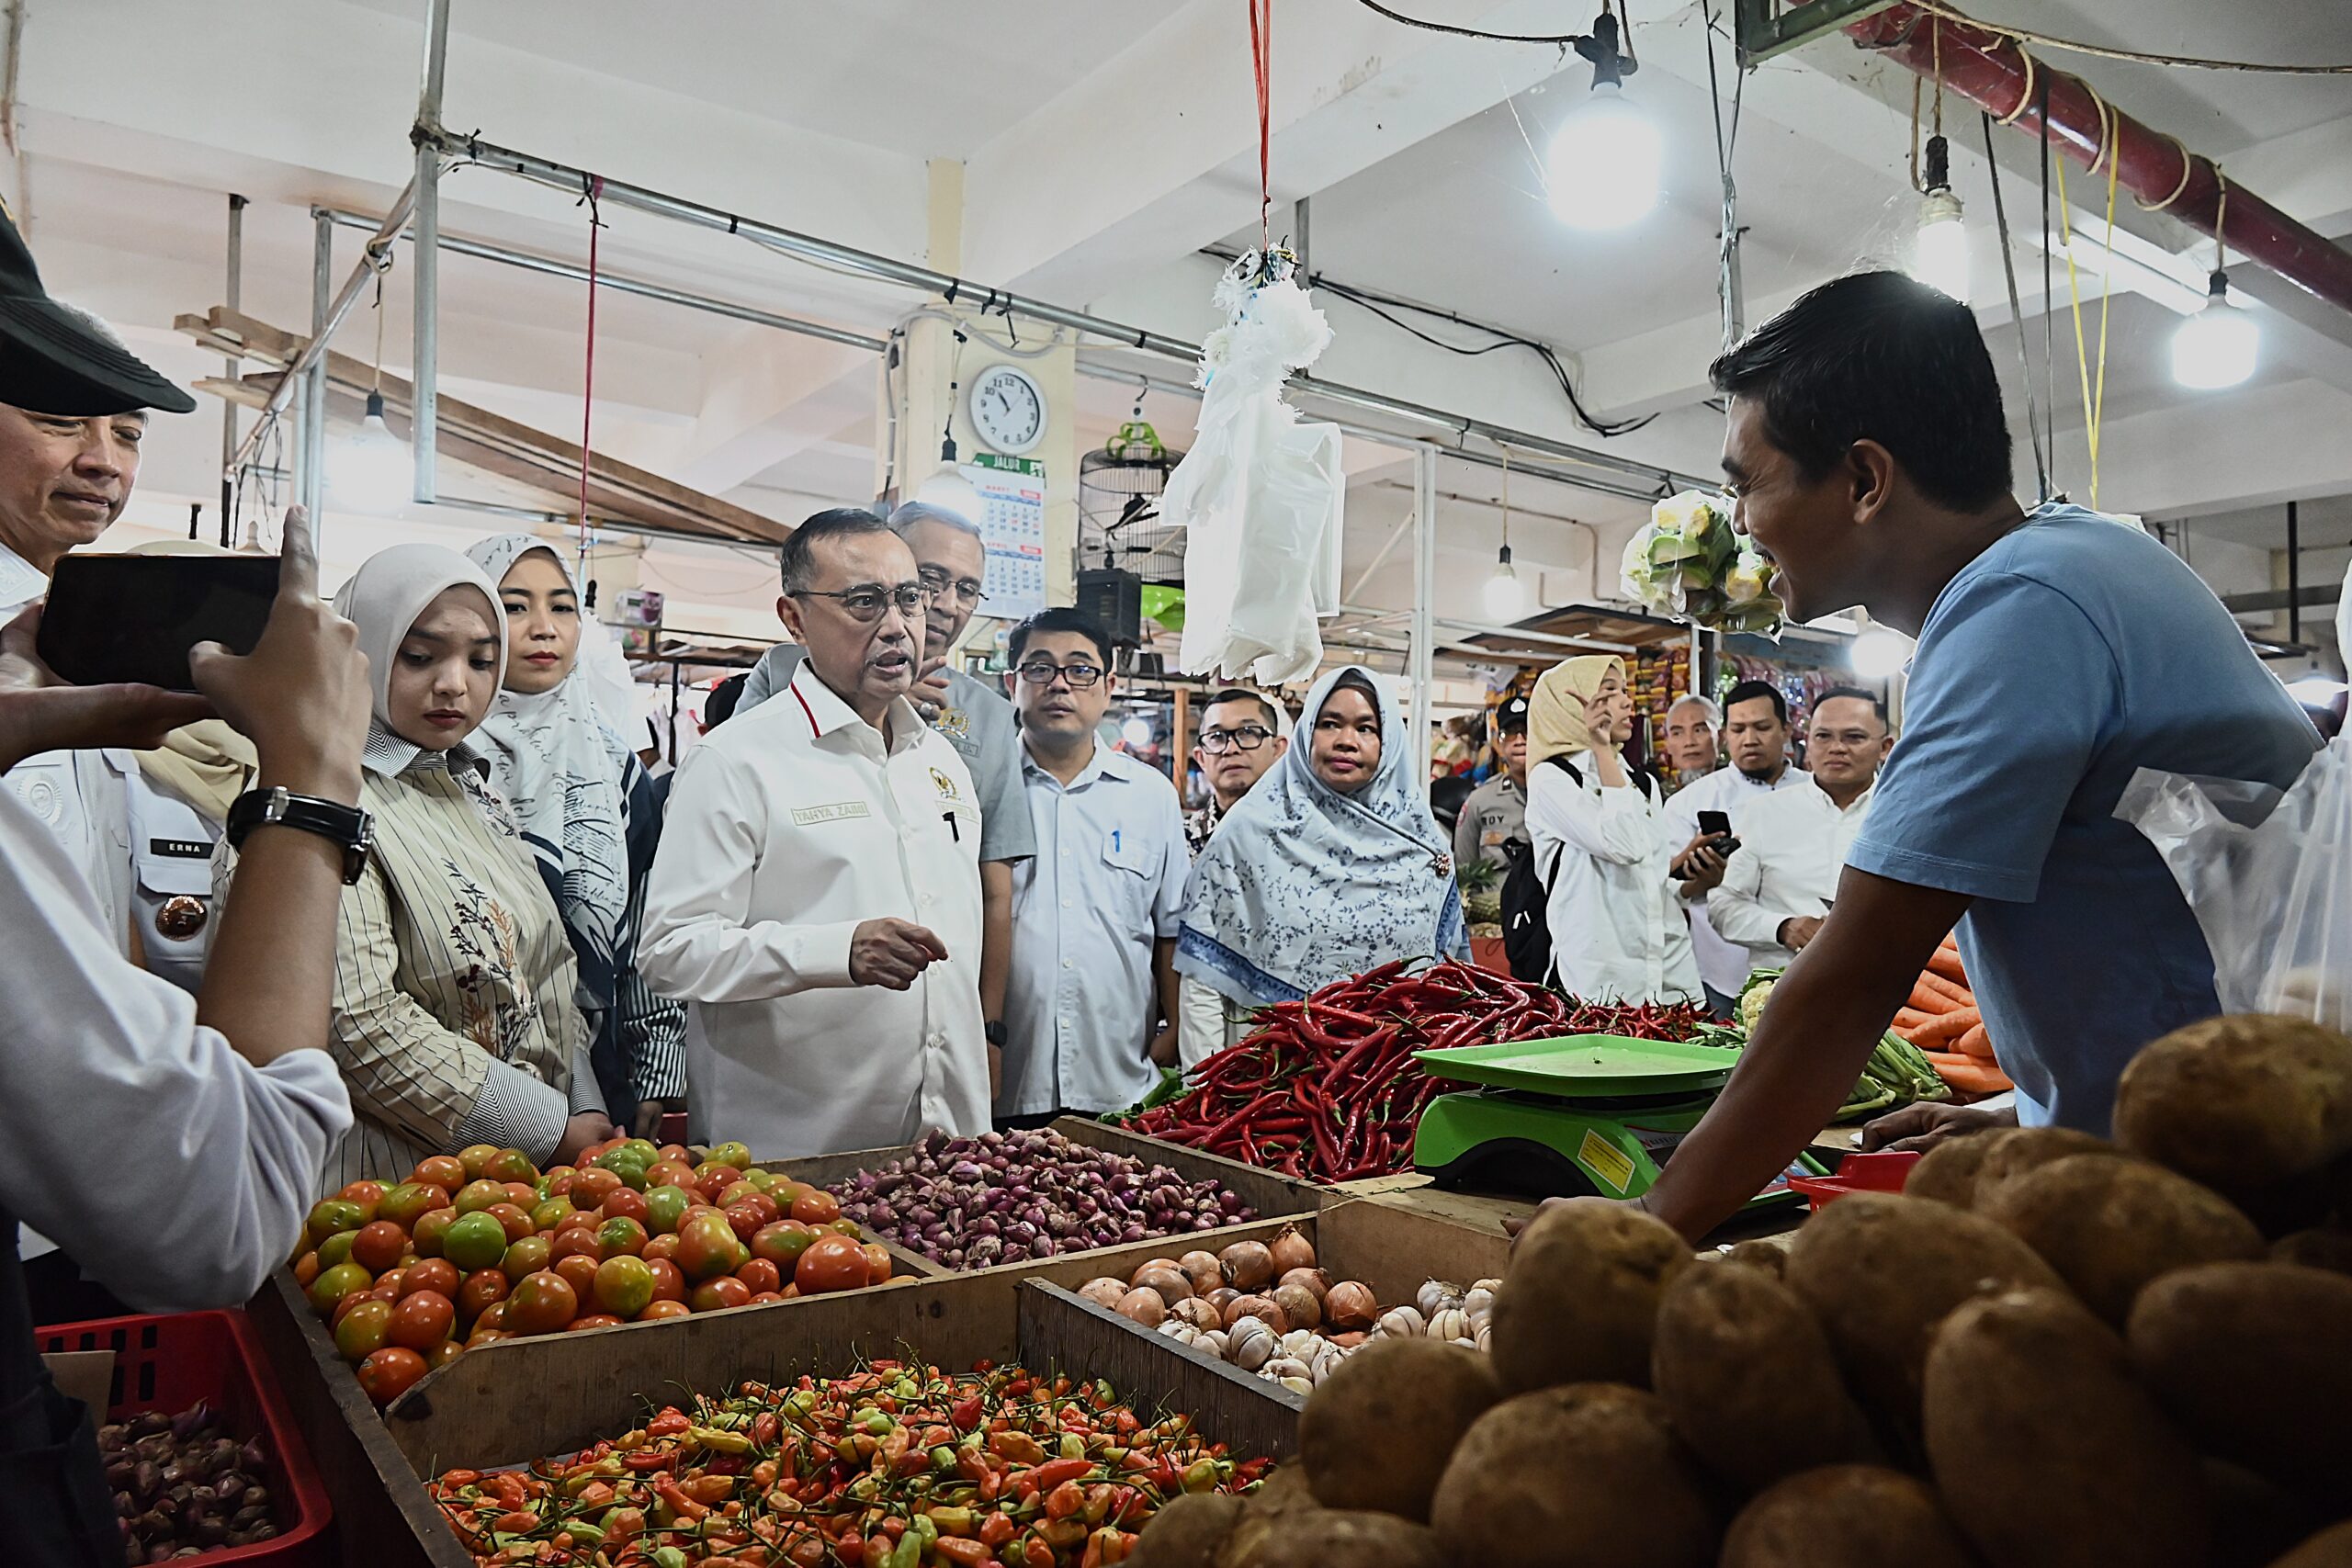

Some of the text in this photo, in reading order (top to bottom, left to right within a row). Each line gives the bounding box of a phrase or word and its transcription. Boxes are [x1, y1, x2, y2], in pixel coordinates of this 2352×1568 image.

[993, 378, 1002, 388] 11
[1004, 377, 1015, 387] 12
[985, 386, 995, 396] 10
[794, 807, 833, 822] YAHYA
[168, 843, 200, 852] ERNA
